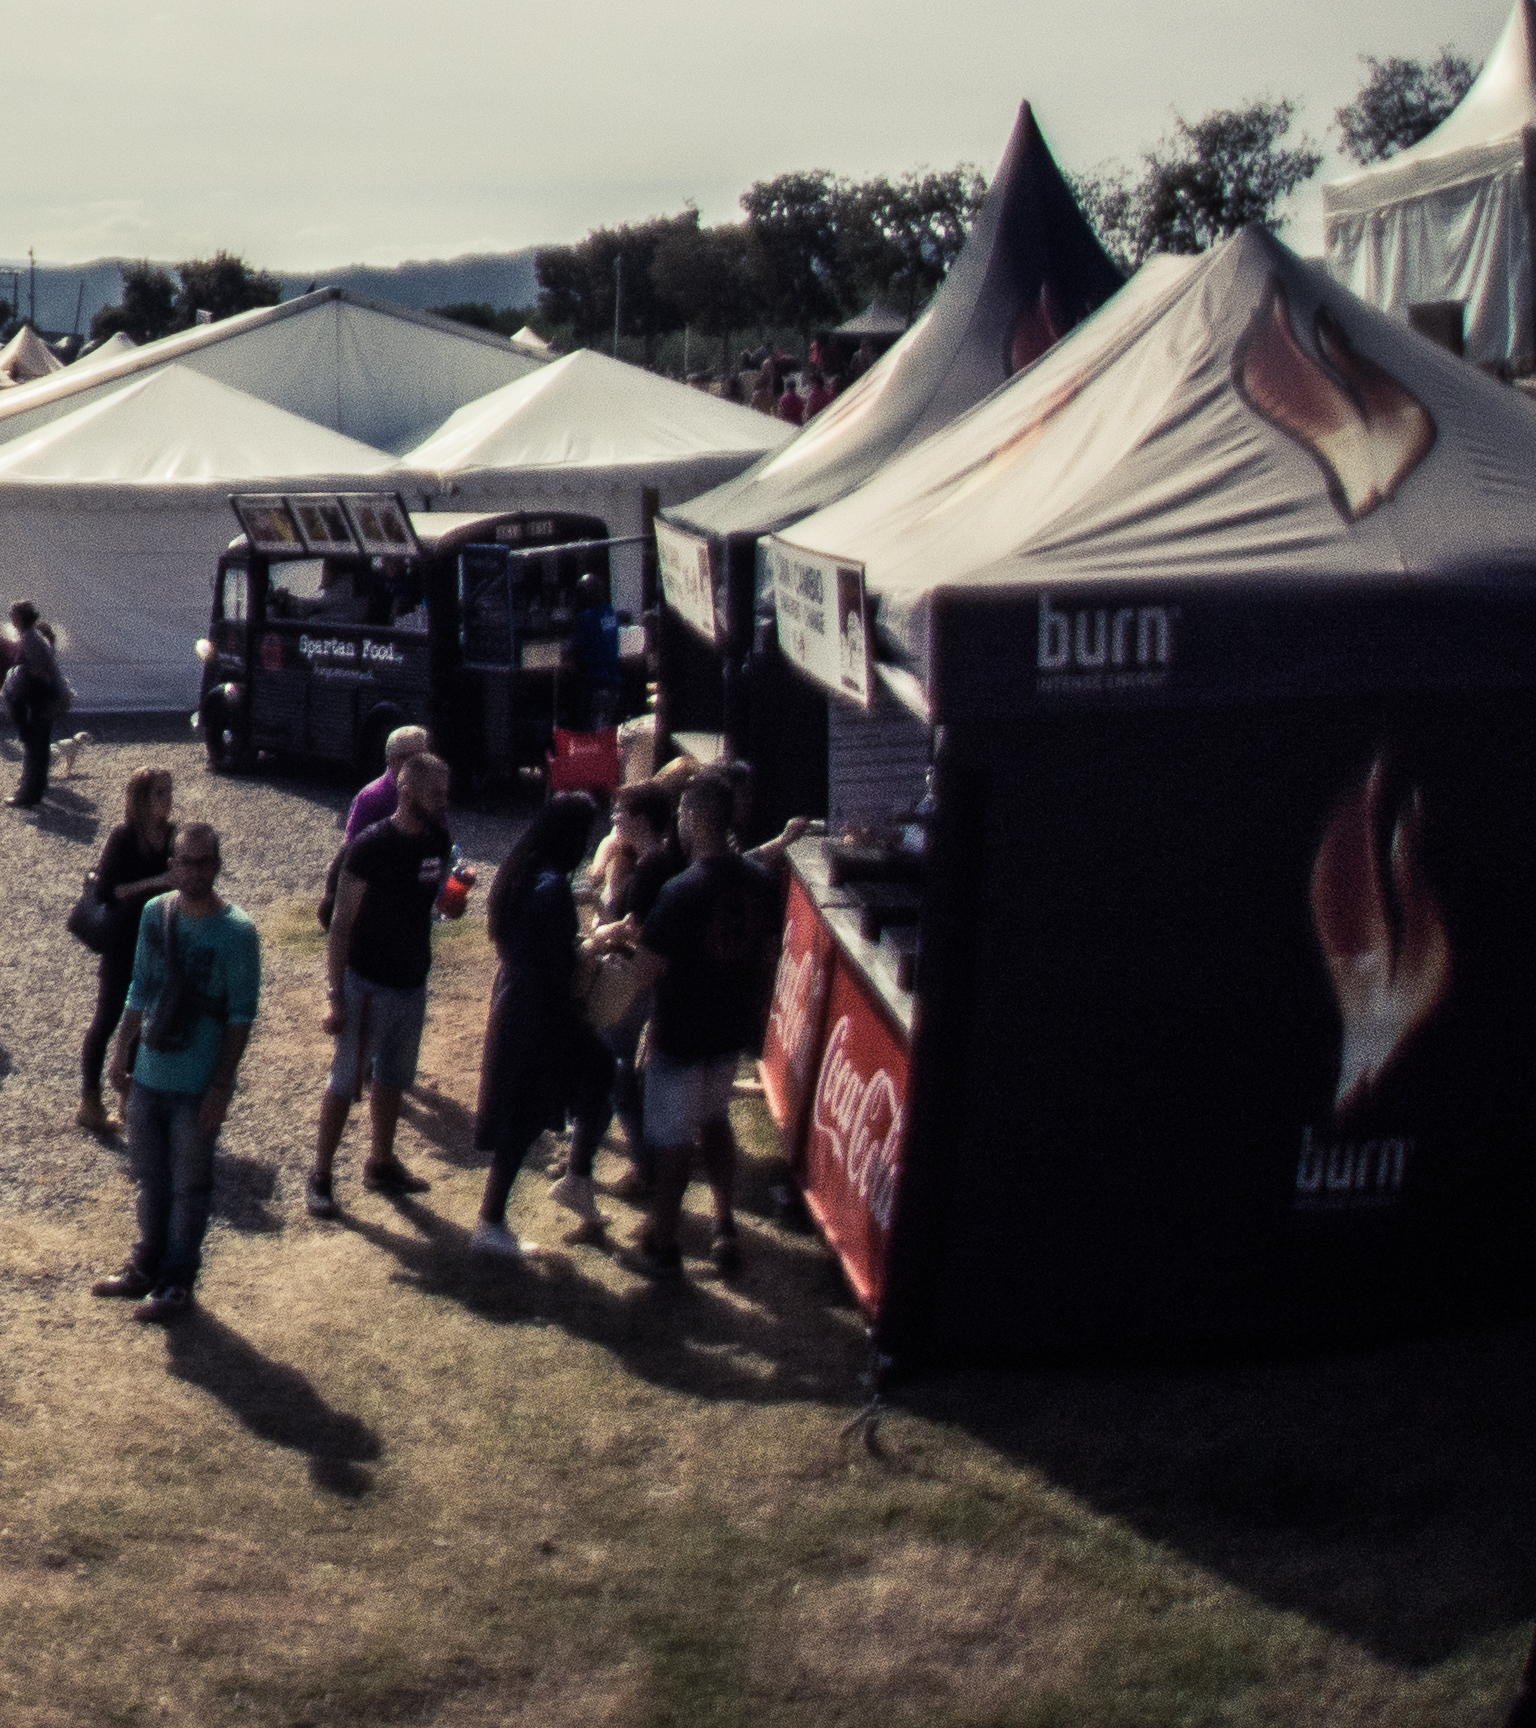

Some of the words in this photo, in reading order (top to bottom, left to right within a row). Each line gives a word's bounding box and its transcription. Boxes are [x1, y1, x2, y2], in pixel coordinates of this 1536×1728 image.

[299, 634, 356, 660] Spartan
[1037, 590, 1168, 668] burn
[1295, 1124, 1406, 1193] burn
